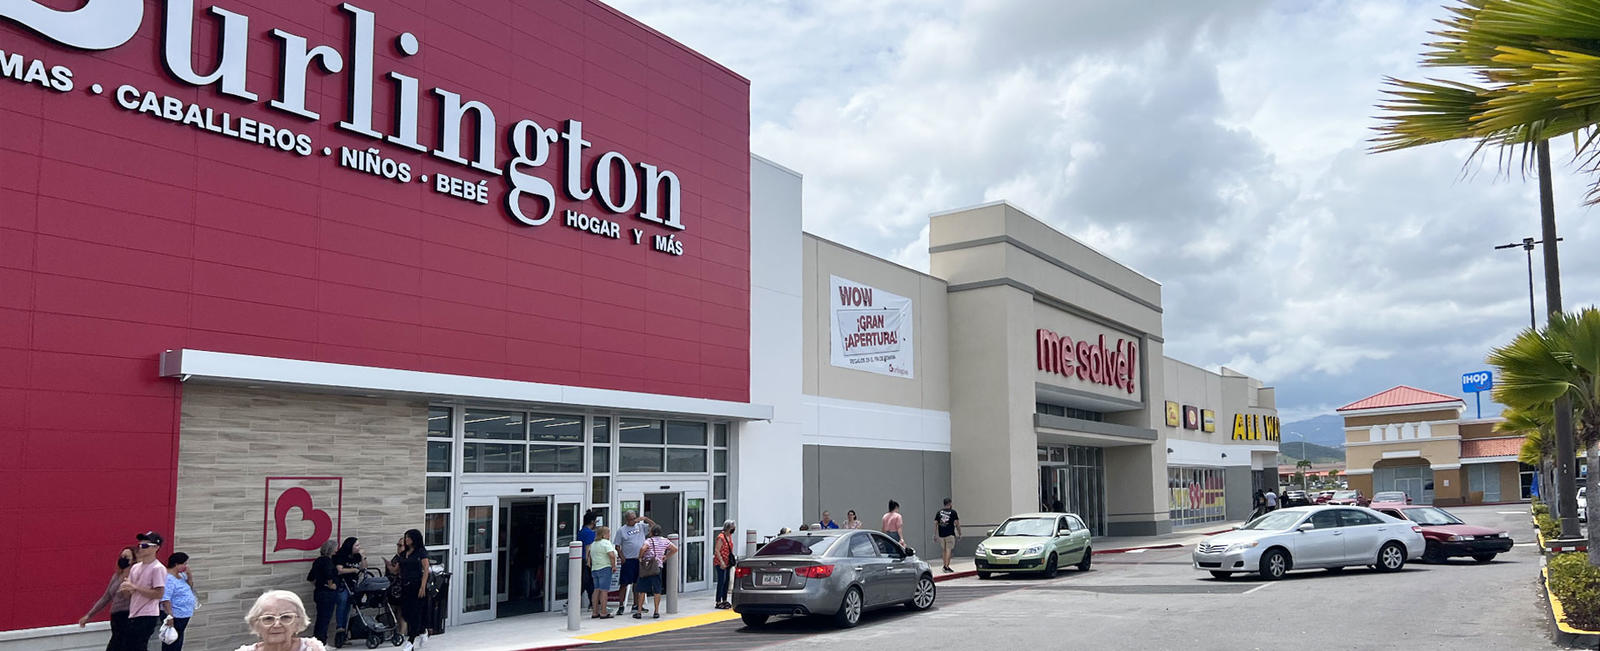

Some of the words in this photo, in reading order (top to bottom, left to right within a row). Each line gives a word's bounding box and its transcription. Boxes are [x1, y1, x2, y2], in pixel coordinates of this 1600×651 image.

[117, 85, 312, 156] CABALLEROS
[341, 147, 412, 183] NIÑOS
[436, 173, 489, 204] BEBÉ
[567, 209, 621, 239] HOGAR
[634, 228, 644, 244] Y
[655, 233, 684, 256] MÁS
[839, 286, 872, 307] WOW
[857, 314, 884, 332] ¡GRAN
[845, 331, 898, 351] ¡APERTURA!
[1037, 328, 1075, 377] me
[1231, 413, 1262, 440] ALL
